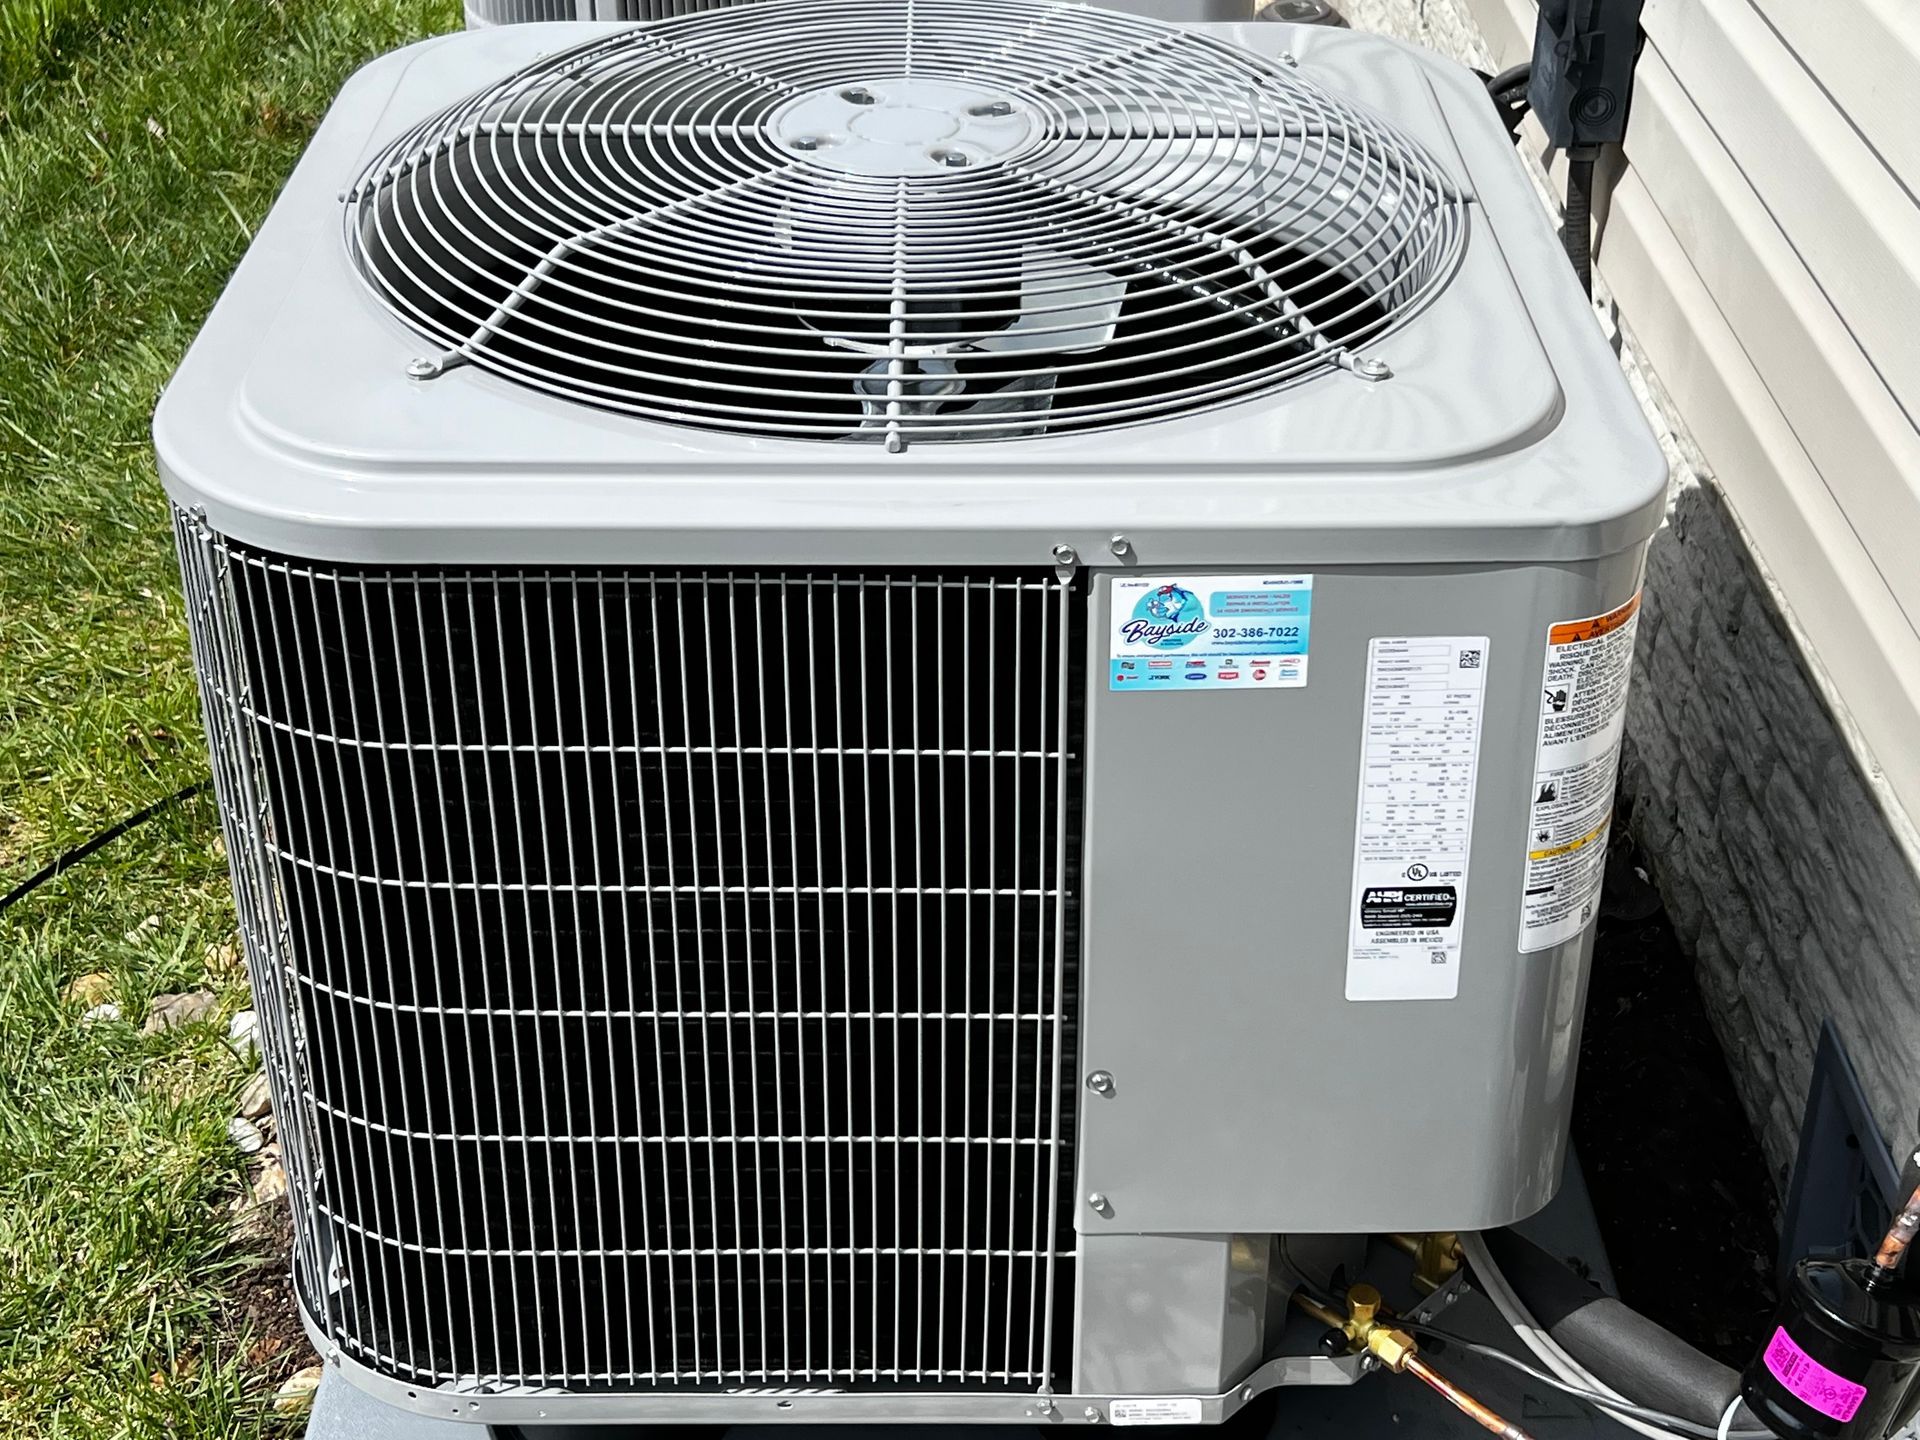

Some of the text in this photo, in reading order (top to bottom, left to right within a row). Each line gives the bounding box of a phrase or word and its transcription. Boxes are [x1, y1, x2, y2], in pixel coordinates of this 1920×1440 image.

[1121, 617, 1208, 645] Bayside
[1213, 627, 1300, 639] 302-386-7022
[1556, 639, 1604, 653] ELECTRICAL
[1559, 649, 1590, 660] RISQUE
[1572, 683, 1610, 698] ATTENTION
[1544, 710, 1592, 725] BLESSURES
[1542, 737, 1568, 747] AVANT
[1404, 893, 1450, 901] CERTIFIED
